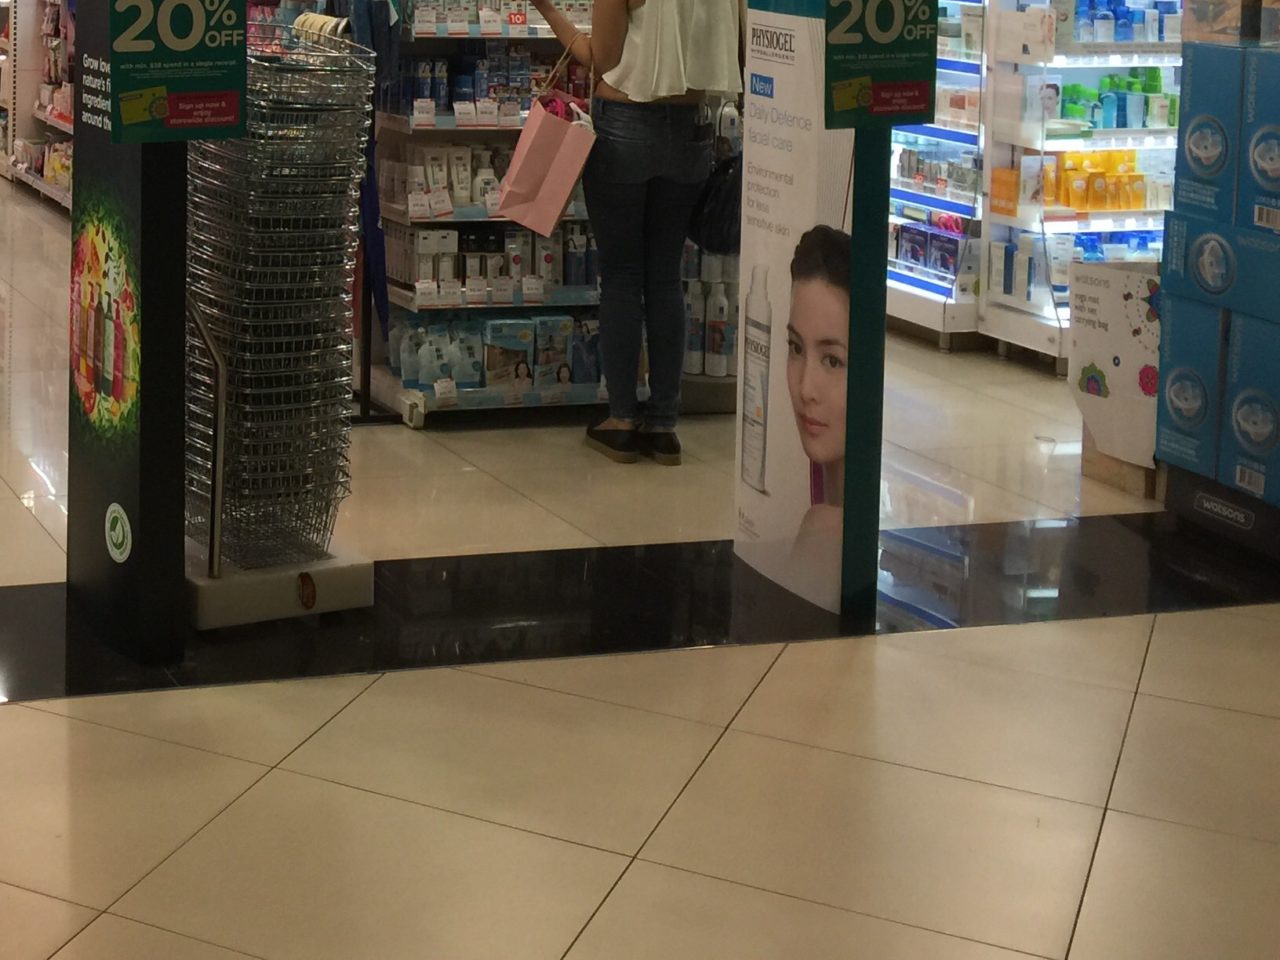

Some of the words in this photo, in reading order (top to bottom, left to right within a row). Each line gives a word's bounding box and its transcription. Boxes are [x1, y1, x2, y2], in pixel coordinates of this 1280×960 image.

[205, 30, 245, 47] OFF
[751, 27, 795, 54] PHYSIOGEL
[903, 23, 935, 40] OFF
[83, 53, 99, 70] Grow
[752, 76, 773, 95] New
[770, 107, 812, 132] Defence
[1202, 499, 1247, 524] watsons
